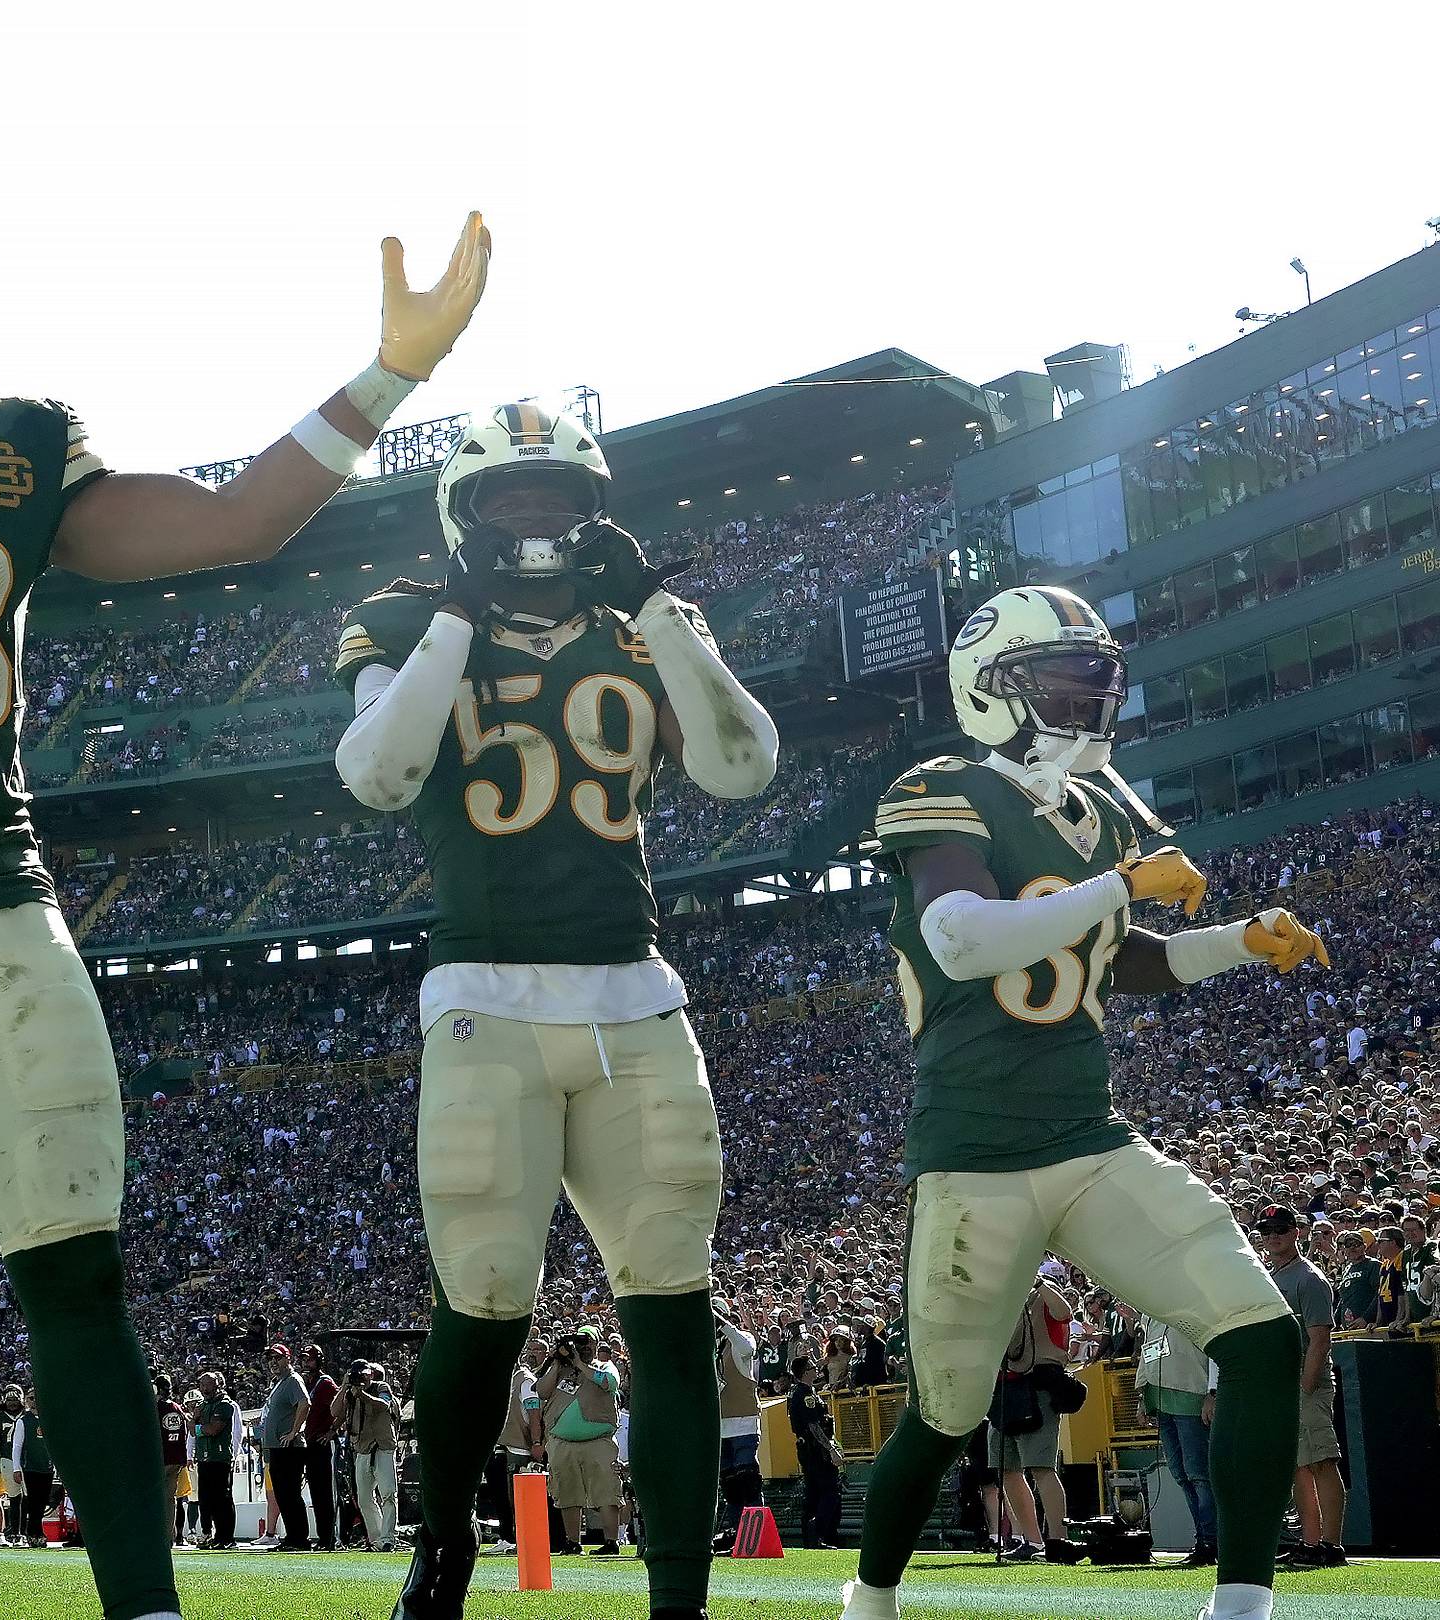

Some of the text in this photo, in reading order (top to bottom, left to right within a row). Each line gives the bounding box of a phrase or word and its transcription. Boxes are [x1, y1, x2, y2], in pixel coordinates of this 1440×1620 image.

[518, 446, 550, 457] PACKERS
[1400, 548, 1435, 570] JERRY
[868, 590, 877, 601] TO
[878, 584, 903, 599] REPORT
[868, 602, 886, 615] CODE
[886, 599, 895, 610] OF
[895, 588, 927, 606] CONDUCT
[866, 604, 918, 628] VIOLATION TEXT
[863, 616, 921, 641] THE PROBLEM AND
[862, 627, 925, 653] PROBLEM LOCATION
[863, 654, 872, 666] TO
[453, 673, 658, 842] 59
[1413, 1015, 1422, 1028] 18
[1265, 1206, 1277, 1217] W
[2, 1421, 15, 1443] 7
[736, 1509, 764, 1556] 10
